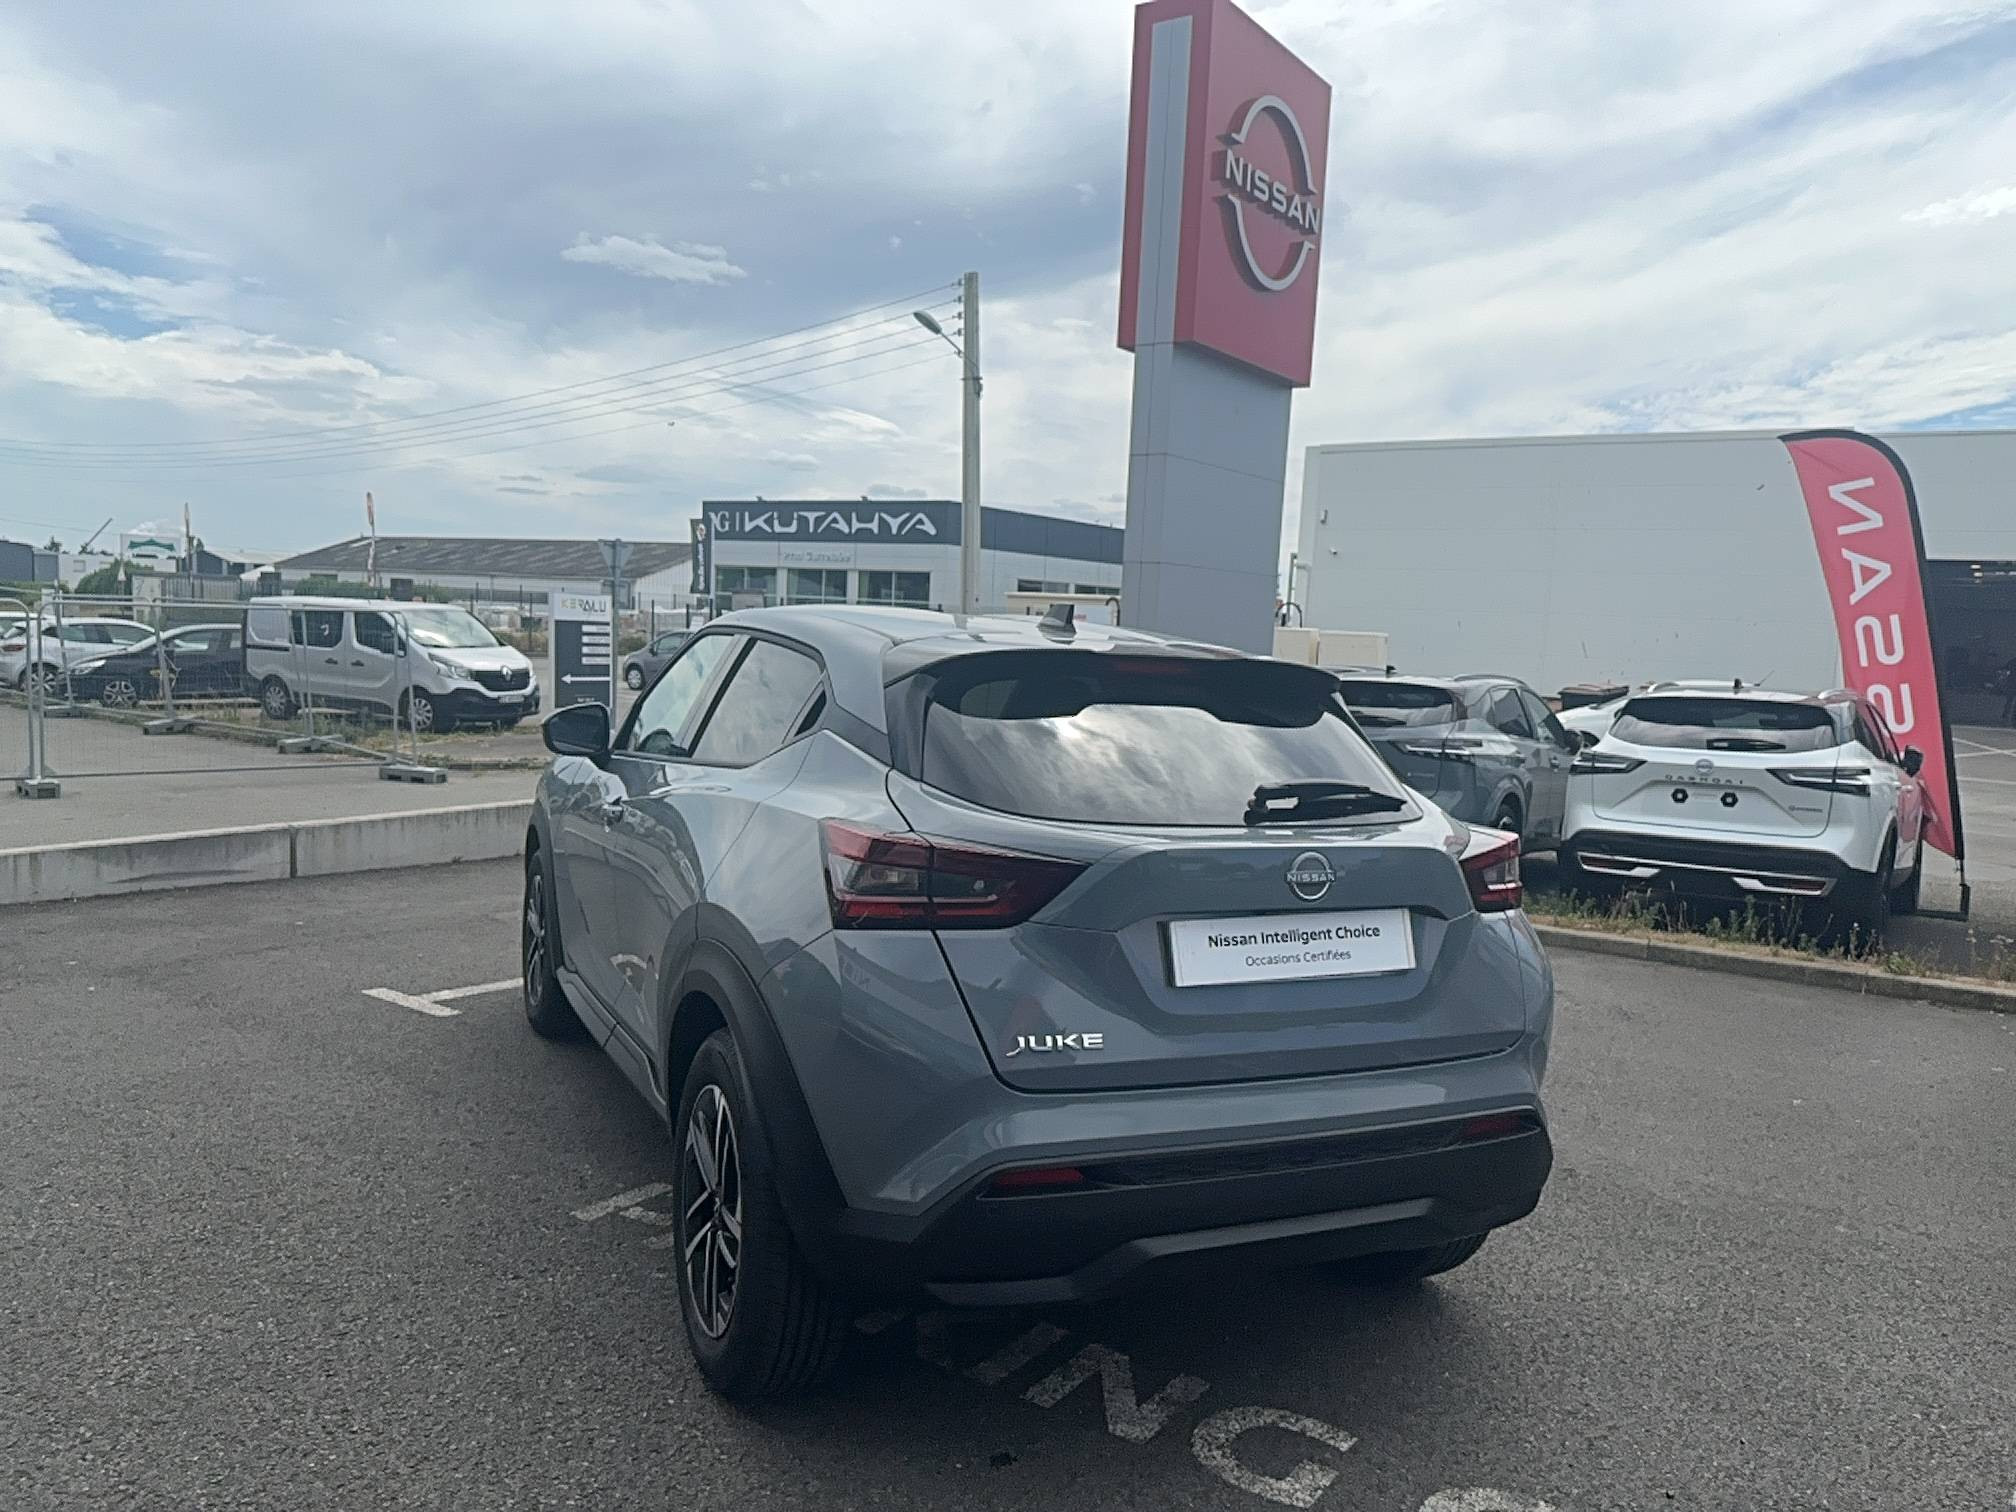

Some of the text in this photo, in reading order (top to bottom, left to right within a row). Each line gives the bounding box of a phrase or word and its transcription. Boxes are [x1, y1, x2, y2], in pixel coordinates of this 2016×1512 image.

[1225, 149, 1321, 233] NISSAN
[1286, 872, 1335, 882] NISSAN
[1208, 924, 1381, 948] Nissan Intelligent Choice
[1245, 949, 1352, 967] Occasions Certifiées
[1005, 1033, 1104, 1057] JUKE
